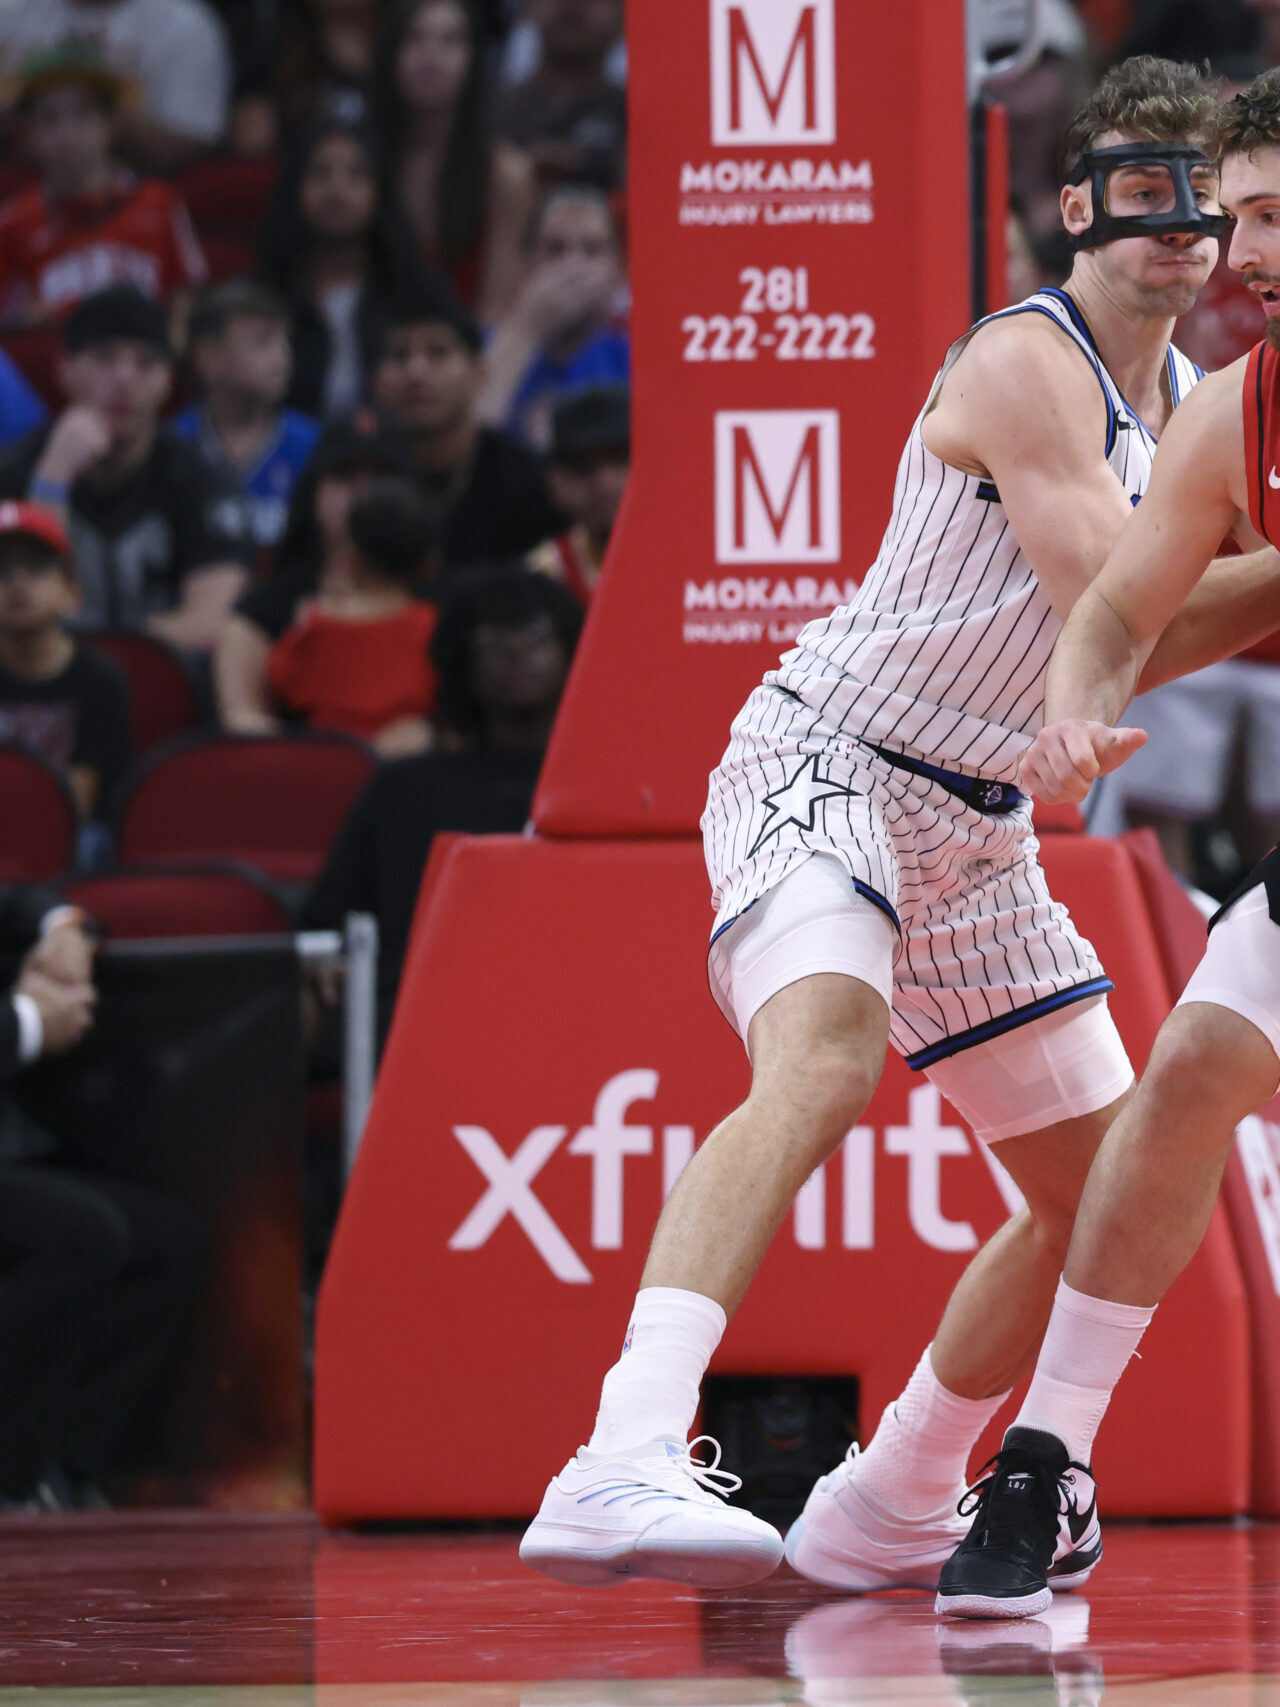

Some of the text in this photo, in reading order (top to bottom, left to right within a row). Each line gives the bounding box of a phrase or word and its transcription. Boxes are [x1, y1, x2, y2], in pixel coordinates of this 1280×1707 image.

[728, 5, 817, 132] M
[681, 159, 873, 192] MOKARAM
[679, 202, 874, 226] INJURY LAWYERS
[739, 266, 808, 312] 281
[682, 314, 875, 361] 222-2222
[731, 424, 821, 550] M
